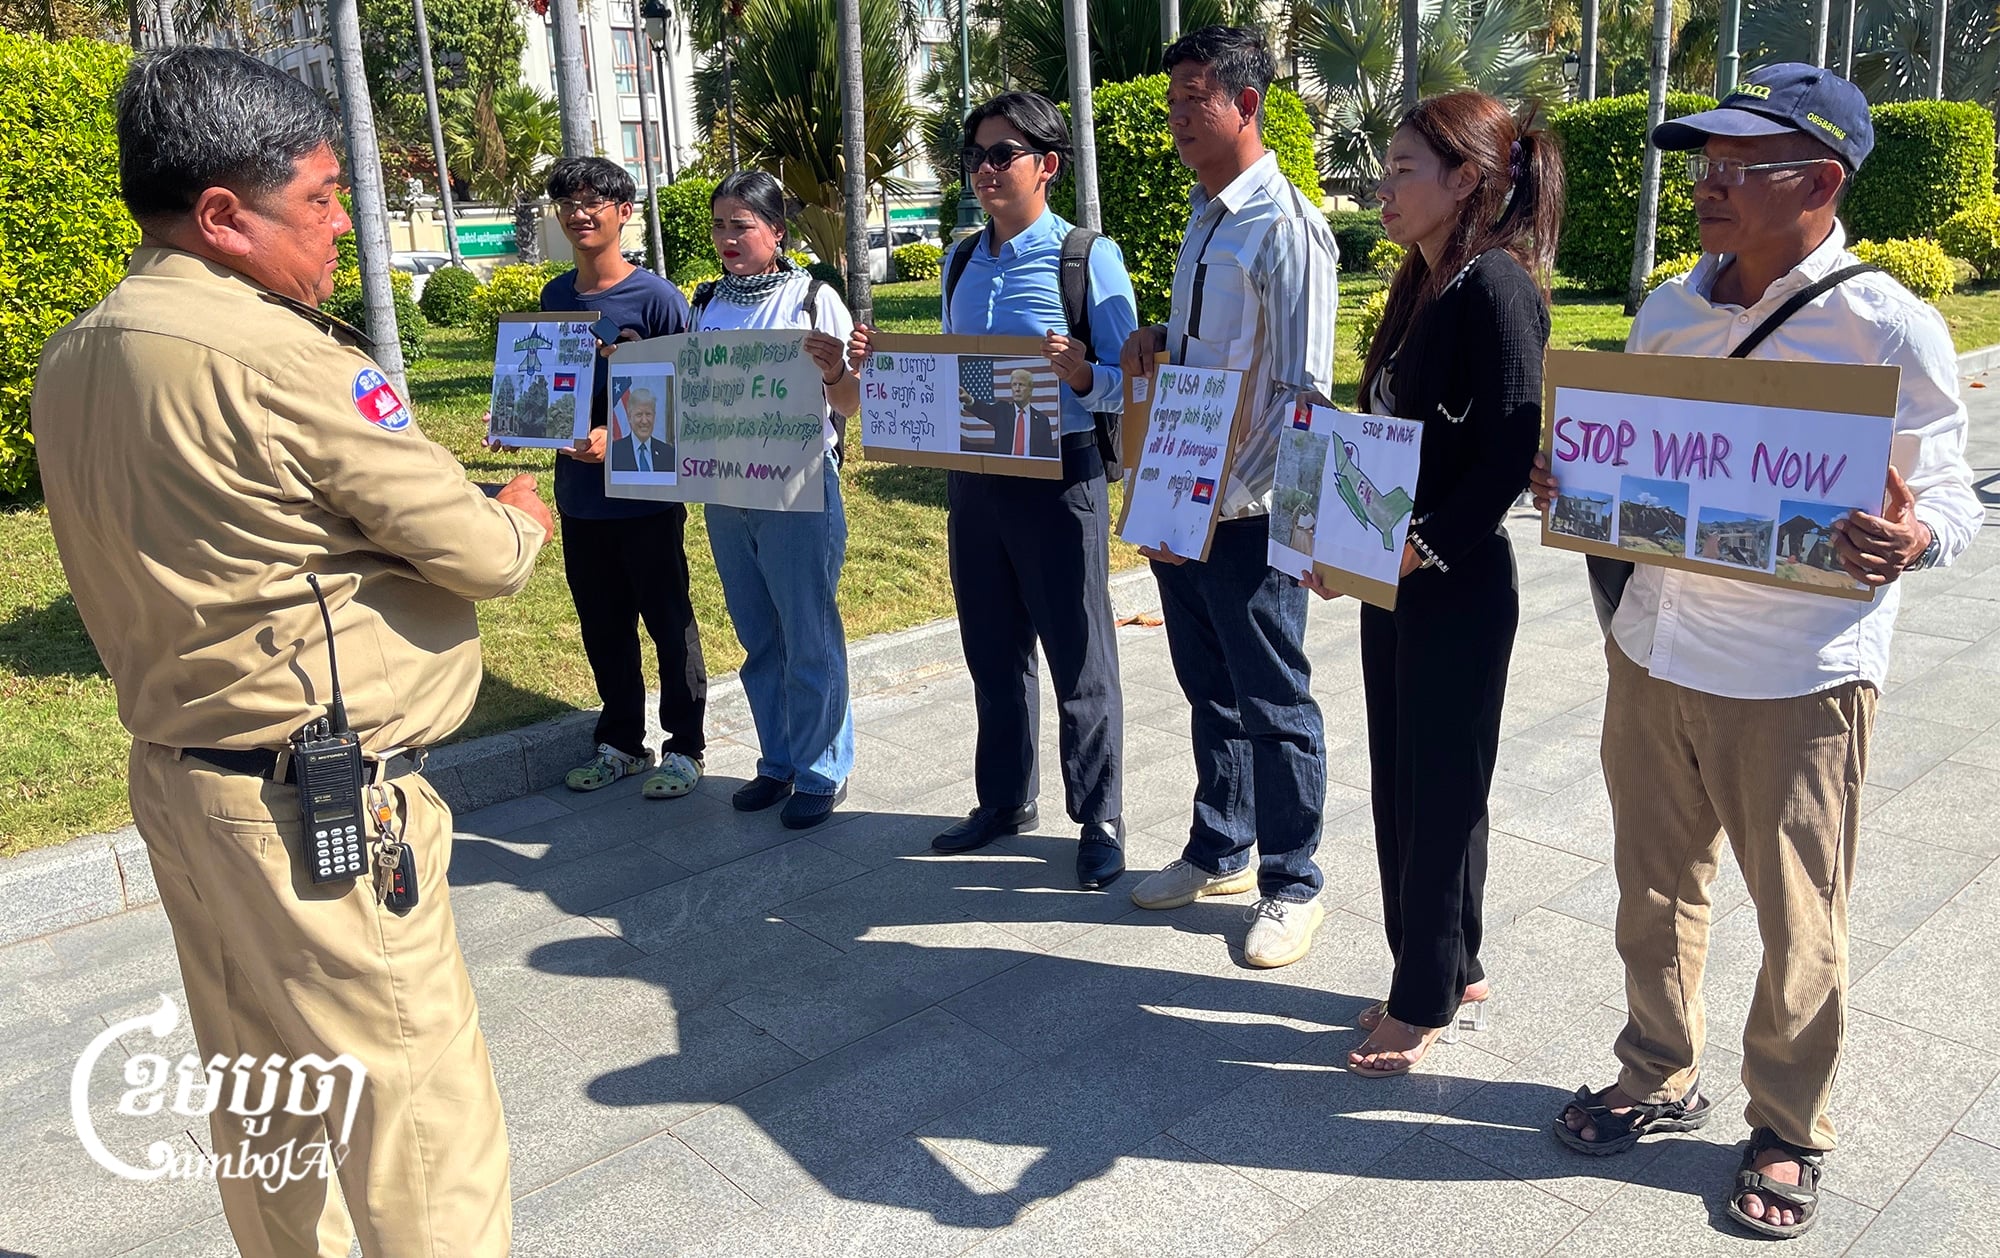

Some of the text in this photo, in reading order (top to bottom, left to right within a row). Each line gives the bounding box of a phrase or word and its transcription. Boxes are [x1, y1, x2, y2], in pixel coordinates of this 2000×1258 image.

[572, 324, 587, 334] USA
[704, 344, 728, 367] USA
[877, 355, 894, 371] USA
[1178, 373, 1200, 396] USA
[1363, 421, 1383, 440] STOP
[1555, 416, 1848, 498] STOP WAR NOW
[682, 457, 791, 481] STOP WAR NOW
